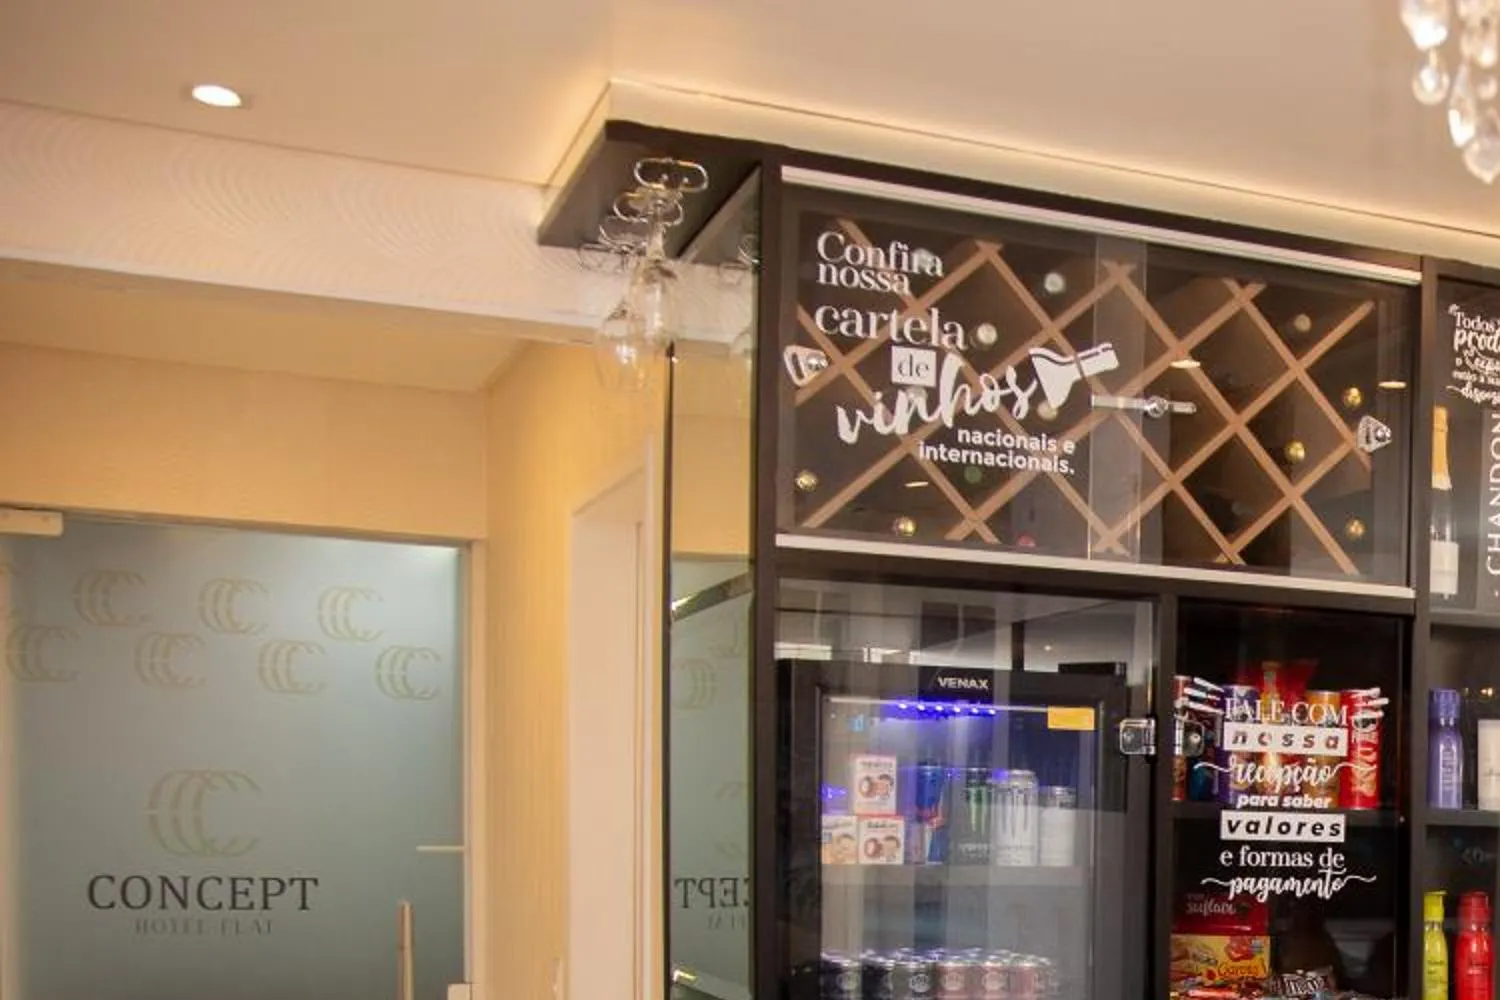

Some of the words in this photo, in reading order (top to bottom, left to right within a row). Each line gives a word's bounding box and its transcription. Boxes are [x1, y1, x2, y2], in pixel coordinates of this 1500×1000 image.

[817, 231, 944, 278] Confira
[818, 262, 911, 296] nossa
[815, 304, 967, 351] cartela
[895, 351, 932, 383] de
[836, 352, 1038, 446] vinhos
[958, 426, 1057, 452] nacionais
[1063, 442, 1076, 455] e
[919, 440, 1076, 475] internacionais.
[938, 677, 989, 690] VENAX
[1225, 697, 1284, 724] FALE
[1292, 701, 1349, 727] COM
[1230, 729, 1341, 751] nossa
[1236, 793, 1277, 809] para
[1283, 792, 1331, 809] saber
[1226, 815, 1342, 838] valores
[1219, 849, 1233, 867] e
[1239, 845, 1313, 868] formas
[1318, 847, 1346, 869] de
[87, 875, 319, 911] CONCEPT
[1228, 869, 1346, 902] pagamento
